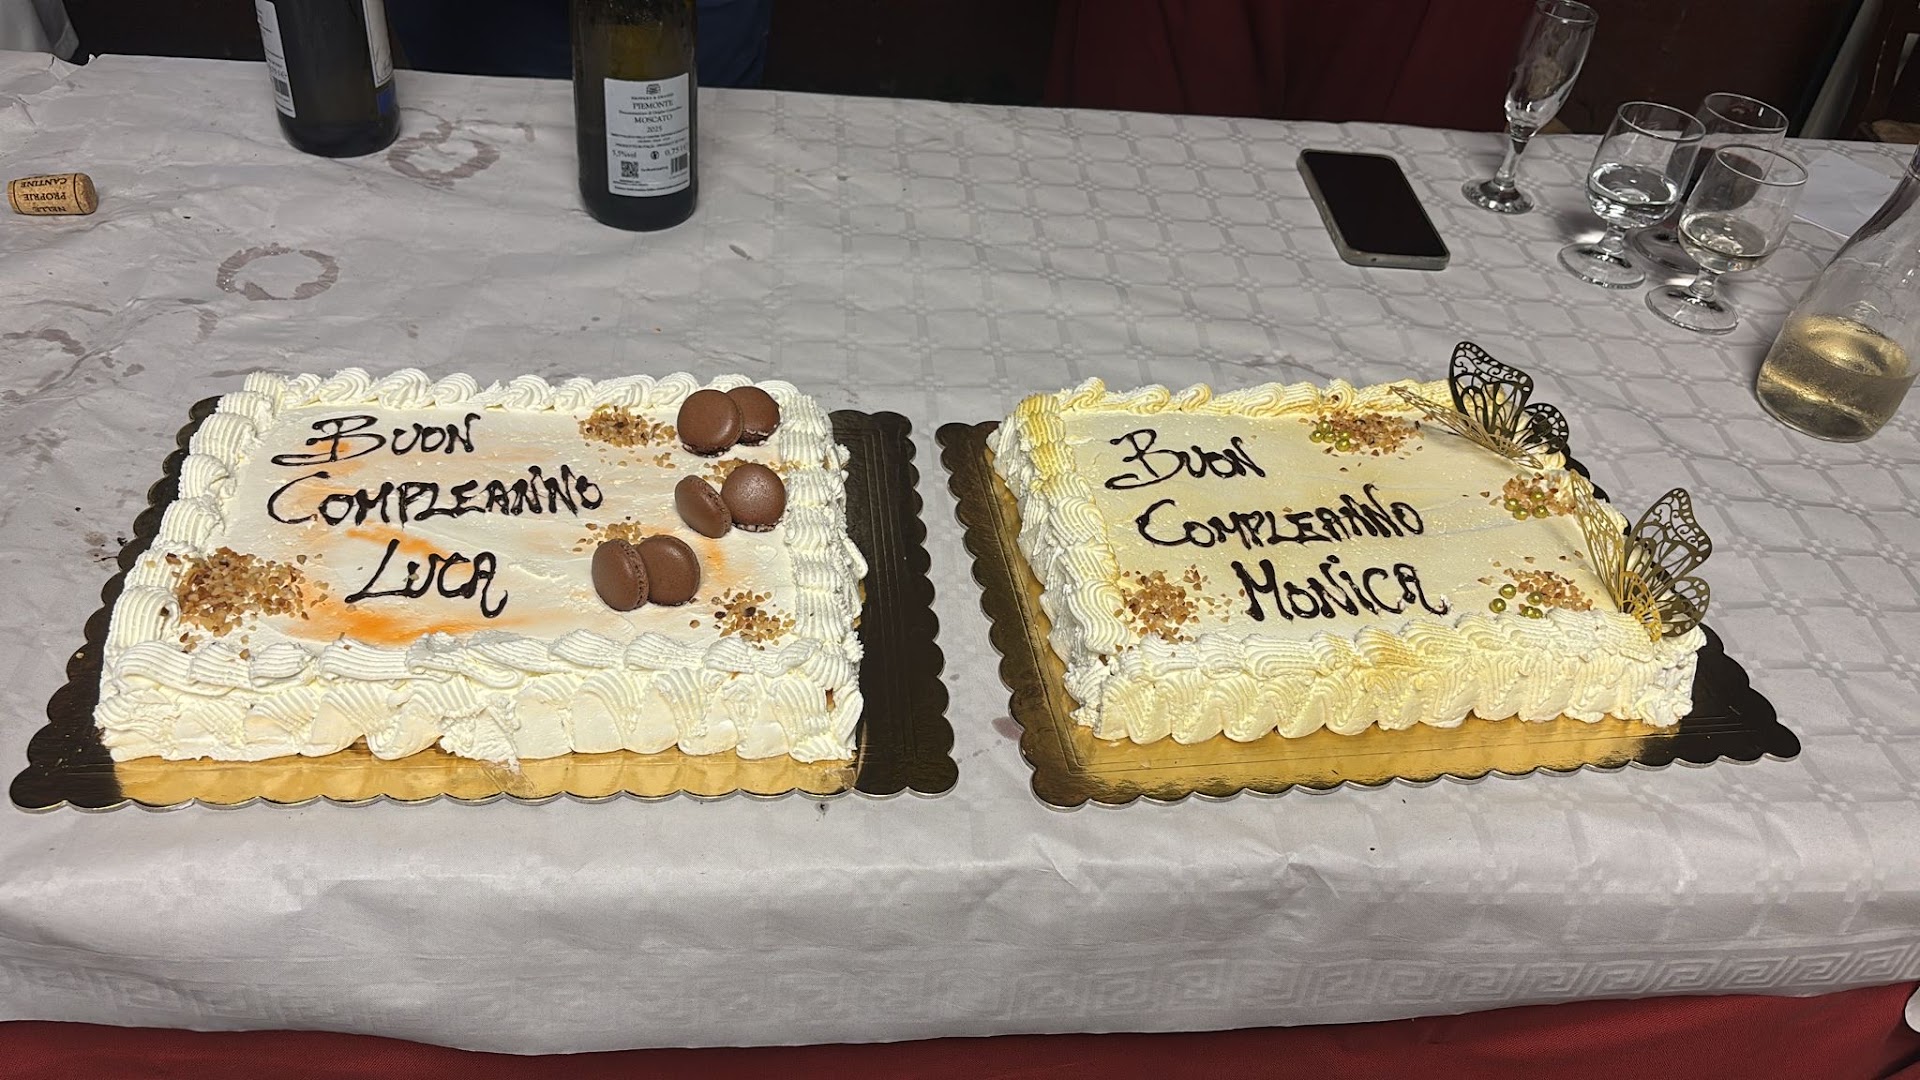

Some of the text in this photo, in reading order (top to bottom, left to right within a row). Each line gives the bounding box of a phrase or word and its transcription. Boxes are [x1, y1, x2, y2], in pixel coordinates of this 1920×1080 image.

[632, 100, 674, 110] PIEMONTE
[634, 114, 673, 124] MOSCATO
[20, 177, 67, 188] CANTINE
[24, 192, 67, 201] PROPRIE
